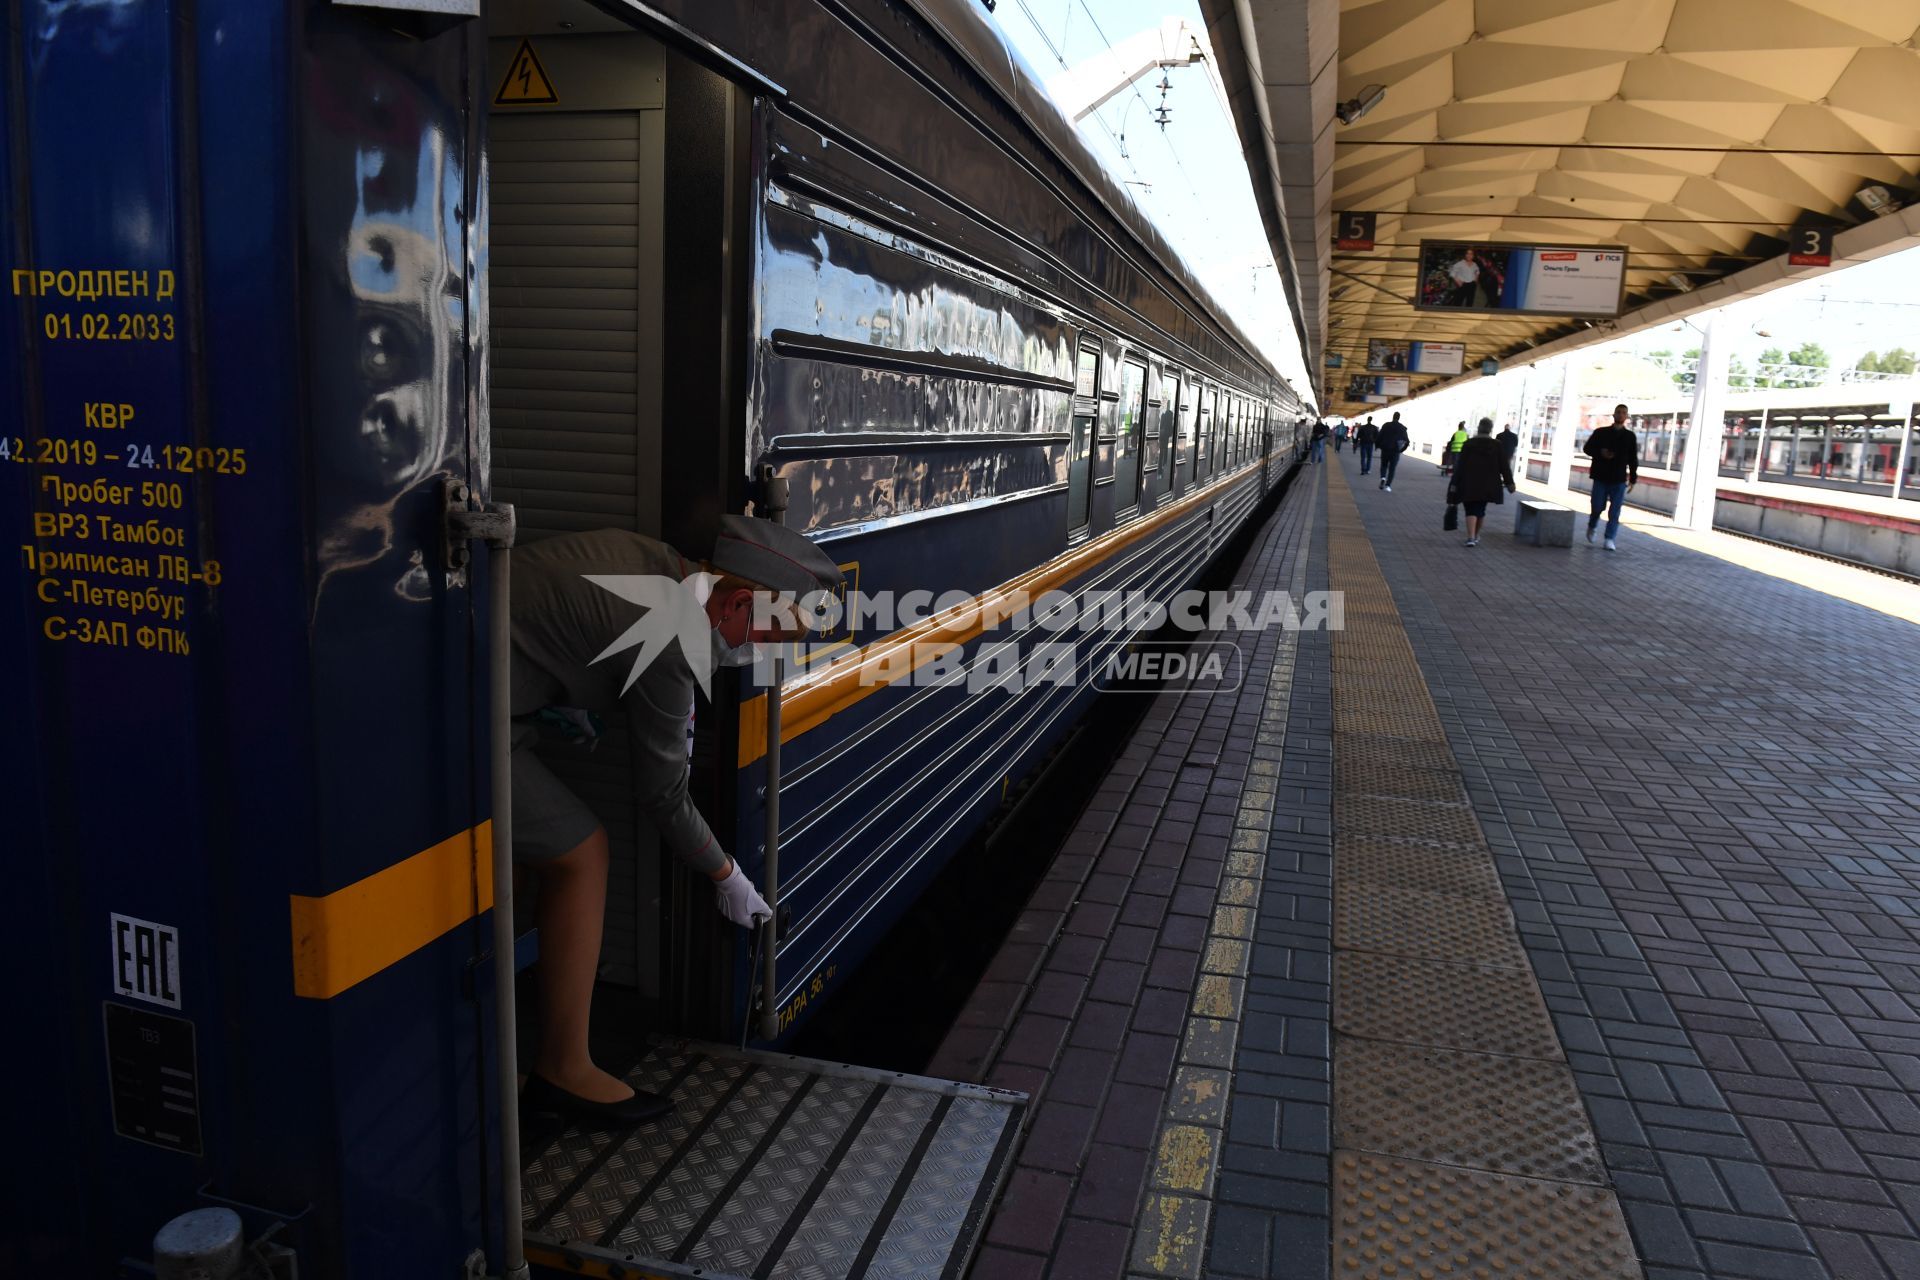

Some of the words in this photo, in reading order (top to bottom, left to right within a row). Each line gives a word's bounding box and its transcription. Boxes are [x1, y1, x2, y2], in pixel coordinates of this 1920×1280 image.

[1349, 216, 1365, 239] 5
[1802, 230, 1820, 255] 3
[12, 269, 149, 302] ПРОДЛЕН
[44, 312, 175, 342] 01.02.2033
[84, 402, 135, 429] КВР
[41, 473, 134, 508] Пробег
[141, 481, 183, 509] 500
